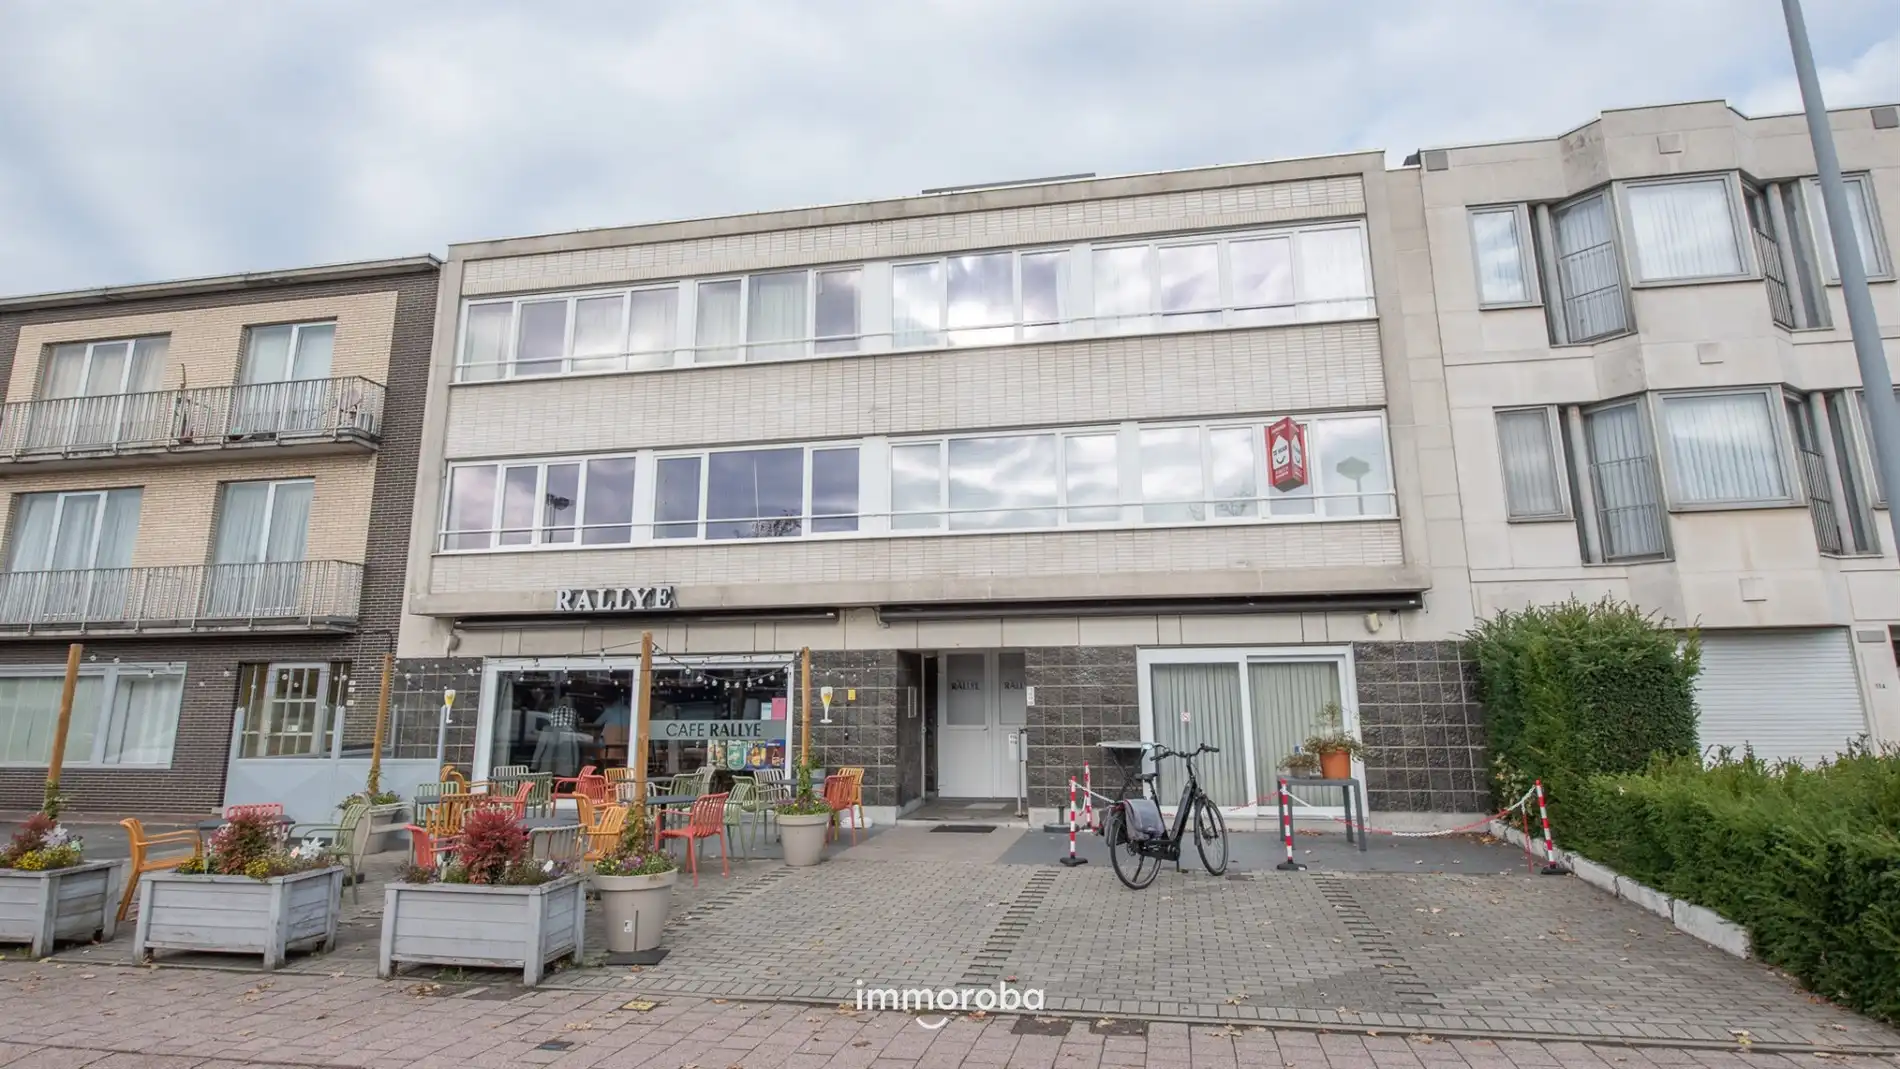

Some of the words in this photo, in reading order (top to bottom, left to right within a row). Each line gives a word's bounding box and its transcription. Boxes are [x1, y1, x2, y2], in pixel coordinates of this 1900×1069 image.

[554, 586, 674, 611] RALLYE
[1004, 681, 1025, 690] RALL
[666, 723, 705, 737] CAFE
[710, 722, 762, 737] RALLYE
